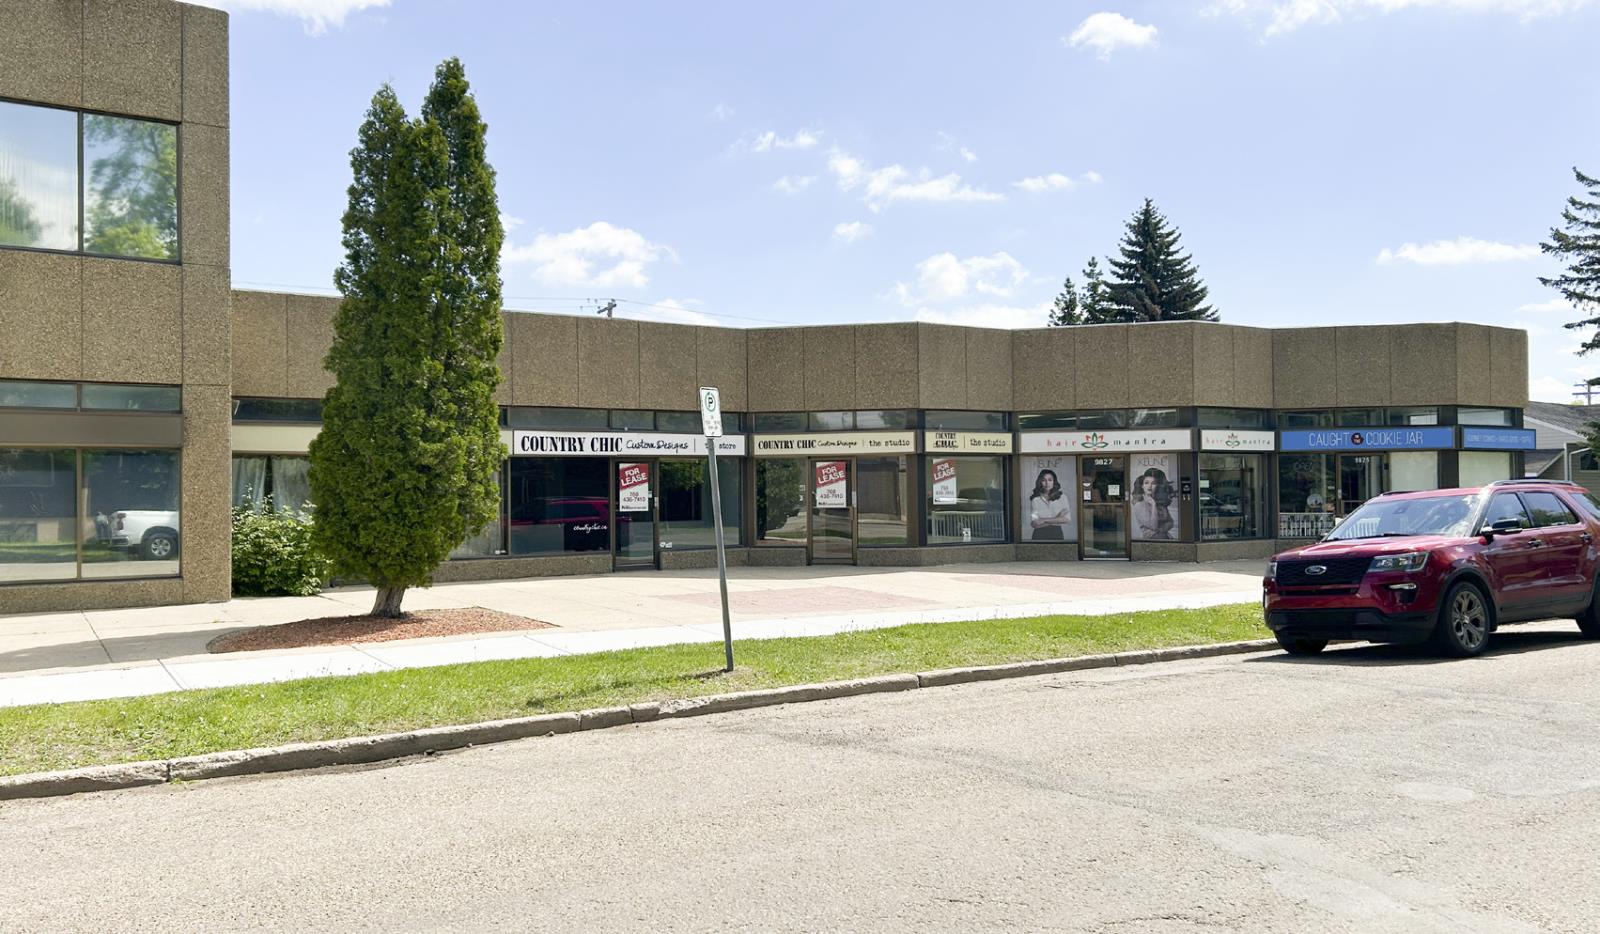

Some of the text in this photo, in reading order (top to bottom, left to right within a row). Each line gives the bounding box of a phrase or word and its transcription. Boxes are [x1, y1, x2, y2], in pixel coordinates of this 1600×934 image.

[970, 438, 1006, 447] the studio
[1046, 437, 1166, 447] hair mantra
[1309, 432, 1350, 446] CAUGHT
[1365, 431, 1402, 446] COOKIE
[1405, 431, 1424, 445] JAR
[521, 436, 586, 452] COUNTRY
[591, 437, 623, 452] CHIC
[626, 439, 655, 449] Custom
[656, 440, 688, 454] Designs
[758, 440, 795, 450] COUNTRY
[797, 439, 817, 449] CHIC
[885, 439, 910, 447] studio
[624, 467, 640, 477] FOR
[822, 466, 837, 475] FOR
[936, 462, 950, 471] FOR
[620, 472, 648, 486] LEASE
[818, 470, 845, 484] LEASE
[933, 466, 956, 481] LEASE
